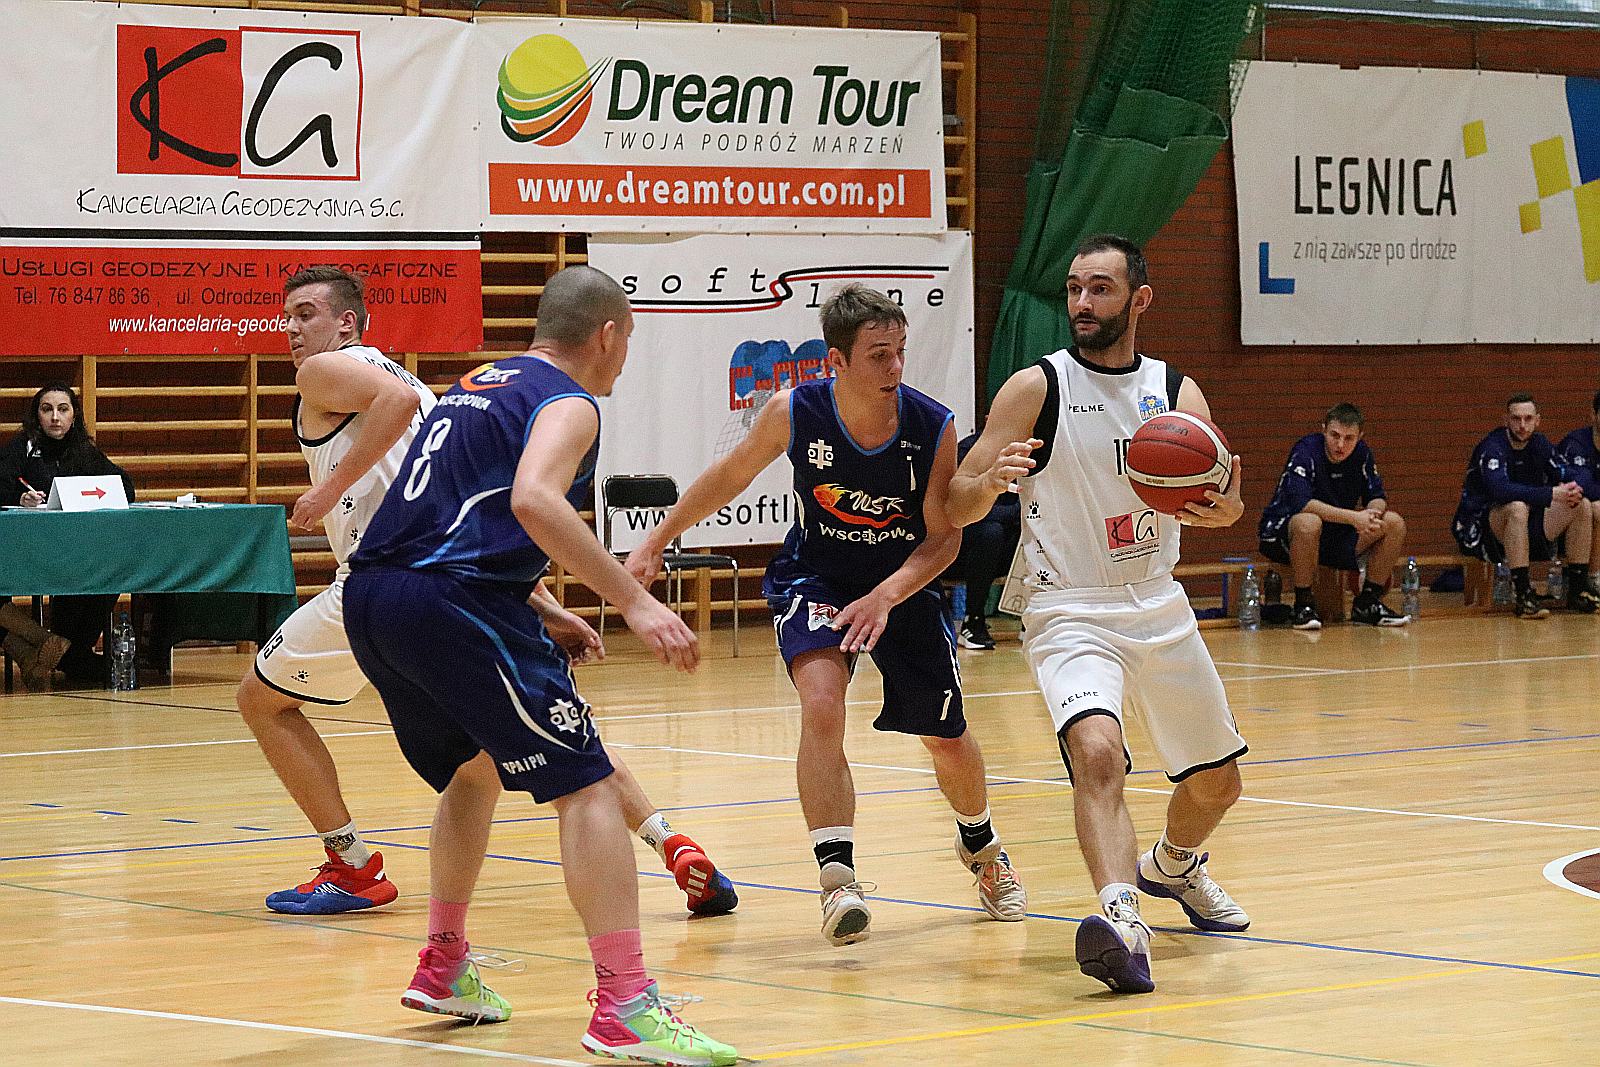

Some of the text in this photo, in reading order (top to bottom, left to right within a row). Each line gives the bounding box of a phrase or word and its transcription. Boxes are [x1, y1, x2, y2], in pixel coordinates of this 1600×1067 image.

[607, 59, 921, 127] Dream Tour
[604, 131, 903, 154] TWOJA PODRÓŻ MARZEŃ
[517, 171, 905, 213] www.dreamtour.com.pl
[1294, 156, 1456, 216] LEGNICA
[76, 188, 404, 217] KANCELARIA GEODEZYJNA S.C.
[1294, 237, 1457, 265] z nią zawsze po drodze
[3, 258, 457, 279] USŁUGI GEODEZYJNE I KAOGAFICZNE
[15, 286, 42, 305] Tel.
[49, 287, 67, 305] 76
[74, 287, 103, 305] 847
[109, 287, 125, 305] 86
[176, 289, 194, 305] ul.
[401, 287, 447, 305] LUBIN
[805, 283, 944, 308] lne
[403, 418, 451, 502] 8
[1061, 691, 1100, 709] KELME
